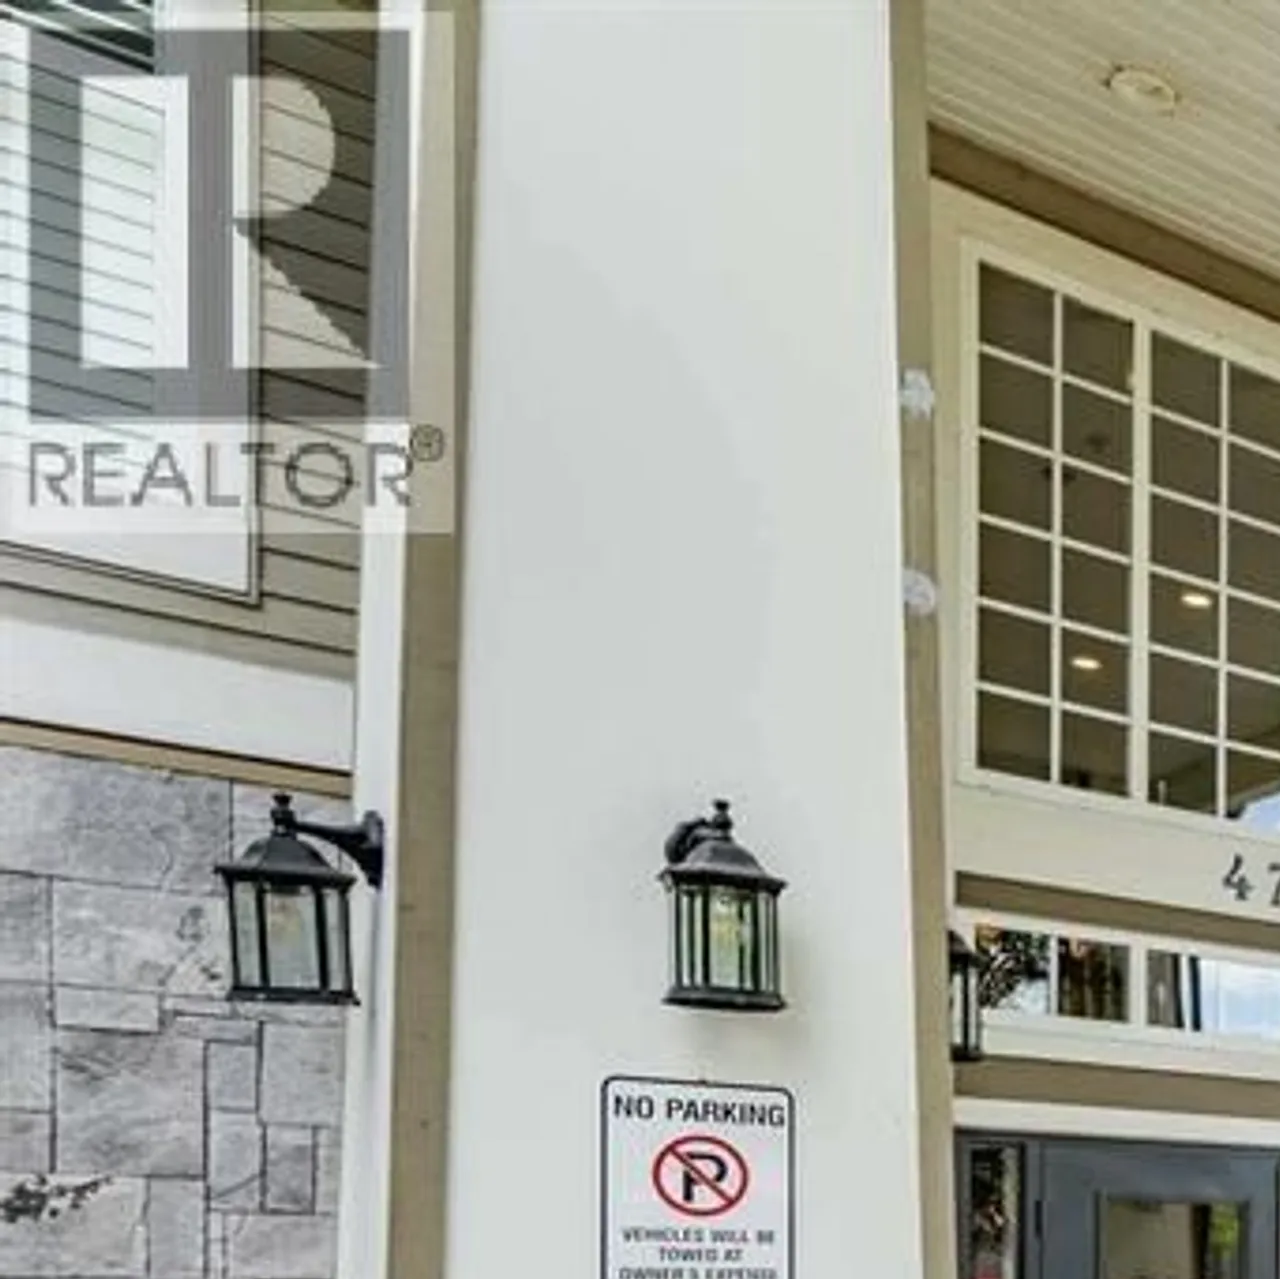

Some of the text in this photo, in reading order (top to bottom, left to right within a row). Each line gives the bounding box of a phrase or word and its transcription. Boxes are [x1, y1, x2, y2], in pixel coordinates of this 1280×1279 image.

[613, 1096, 785, 1127] NO PARKING
[622, 1227, 775, 1243] VEHICLES WILL BE
[659, 1247, 744, 1262] TOWED AT
